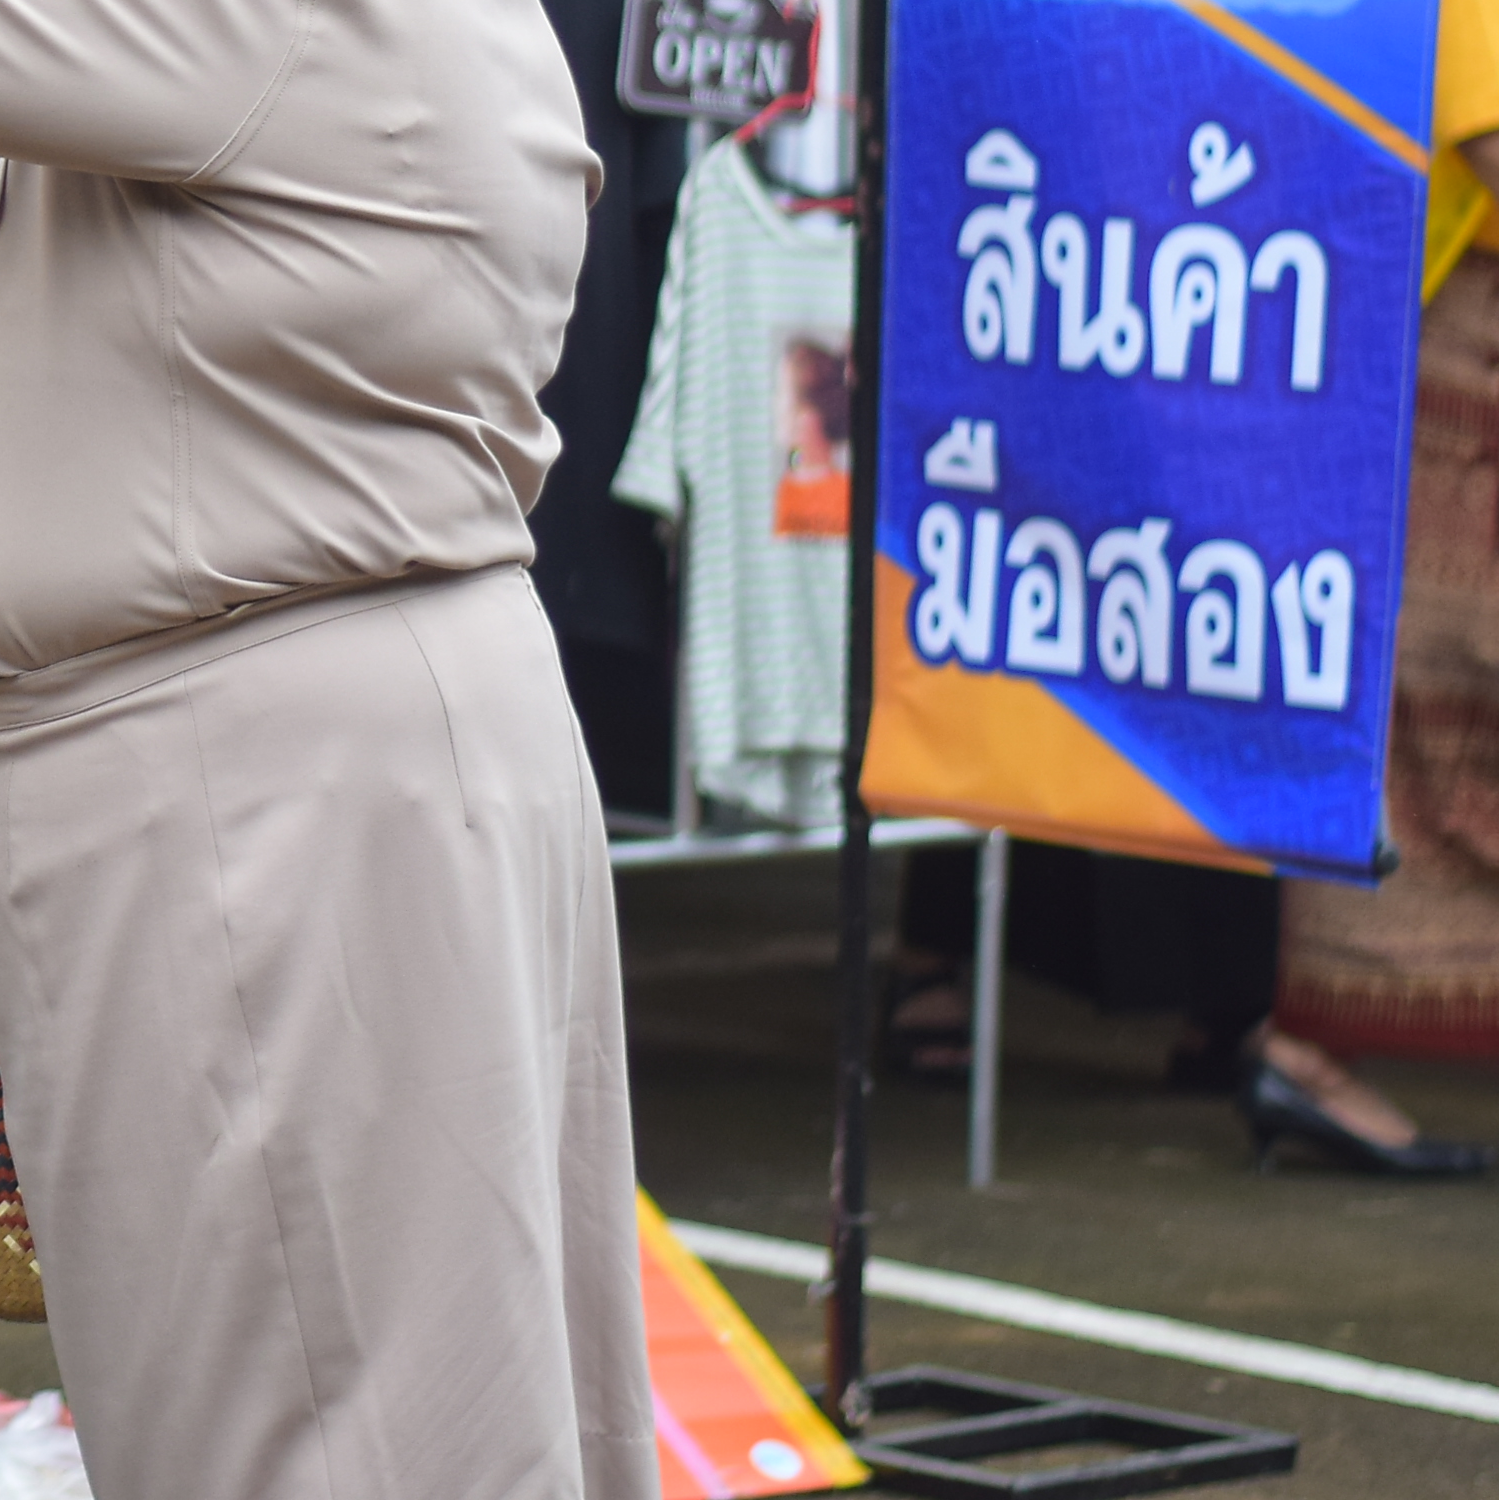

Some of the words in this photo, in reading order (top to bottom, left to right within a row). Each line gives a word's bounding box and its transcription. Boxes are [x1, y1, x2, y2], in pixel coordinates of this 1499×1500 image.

[653, 30, 793, 98] OPEN
[957, 121, 1328, 392] สินค้า
[915, 416, 1355, 711] มือสอง
